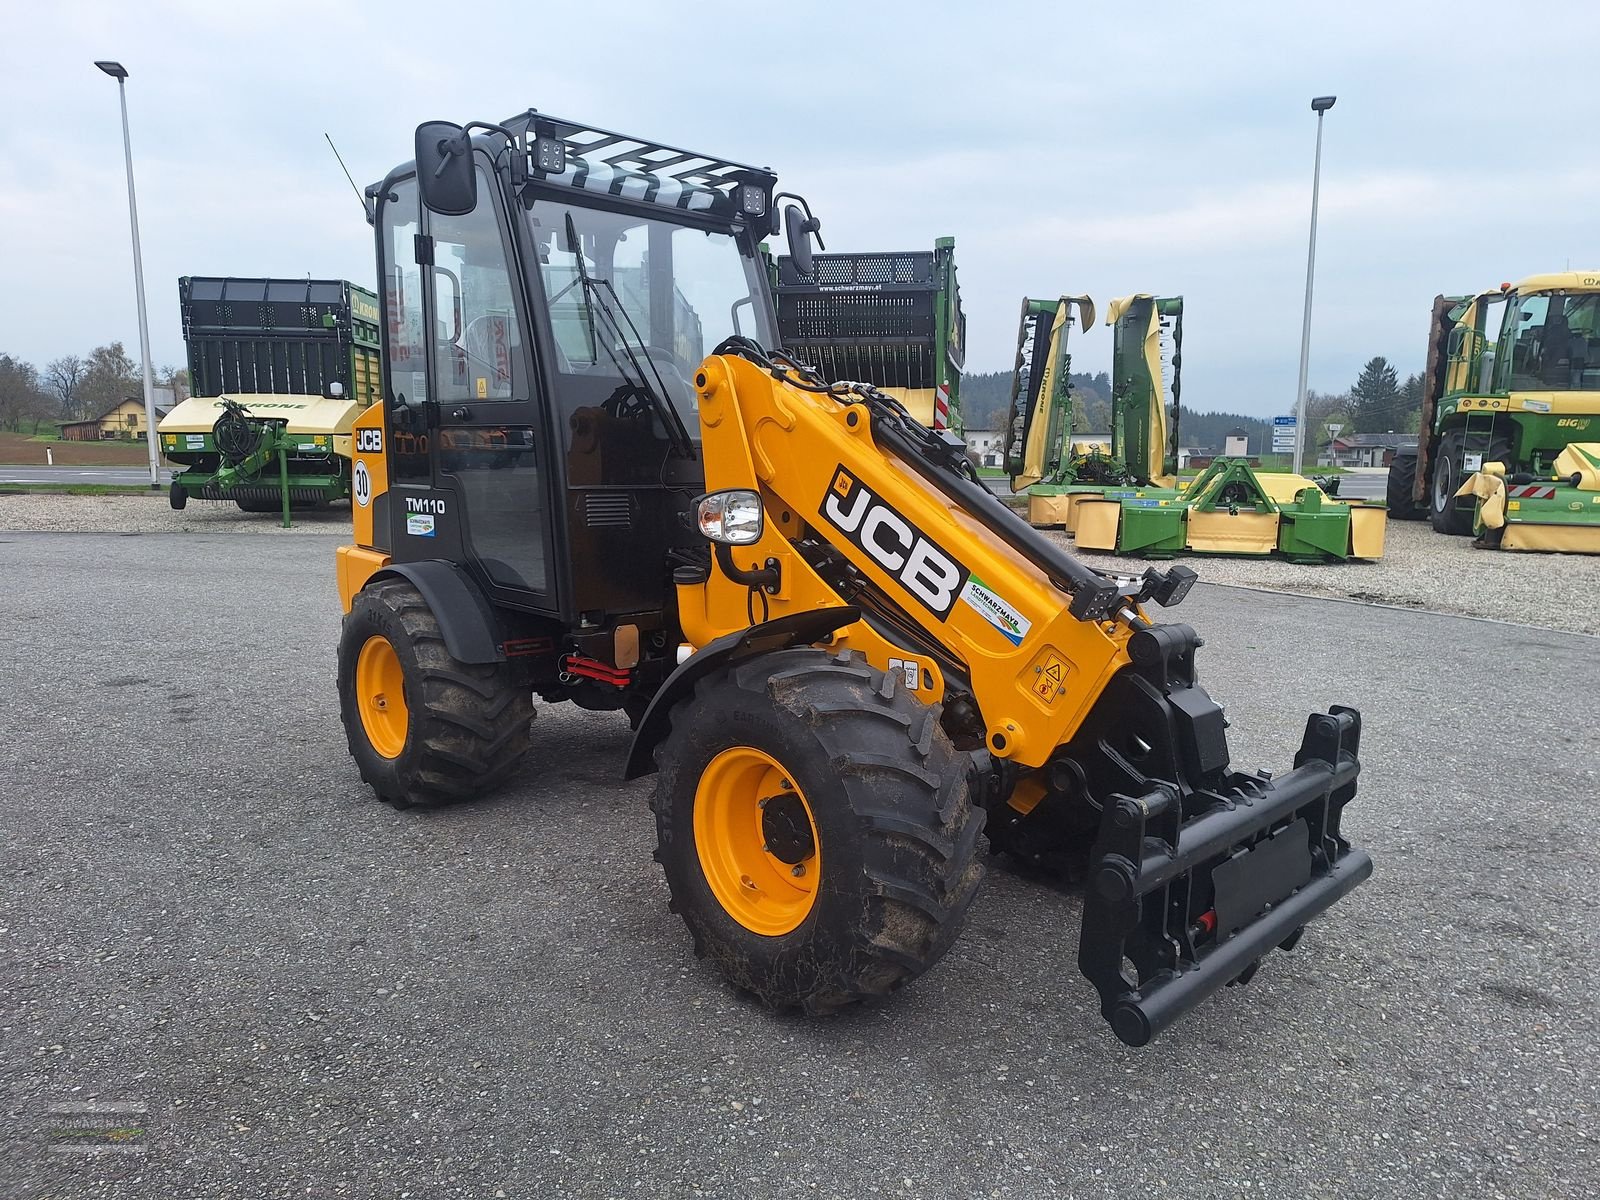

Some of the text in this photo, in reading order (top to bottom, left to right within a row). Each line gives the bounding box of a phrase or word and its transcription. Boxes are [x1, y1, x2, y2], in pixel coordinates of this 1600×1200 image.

[818, 284, 882, 292] www.schwarzmayr.at
[360, 301, 379, 321] KRON
[1040, 379, 1048, 414] KRONE
[356, 429, 383, 451] JCB
[356, 469, 368, 497] 30
[405, 497, 446, 514] TM110
[825, 487, 961, 613] JCB
[970, 591, 998, 616] LANDTECHNIK
[971, 584, 1020, 627] SCHWARZMAYR
